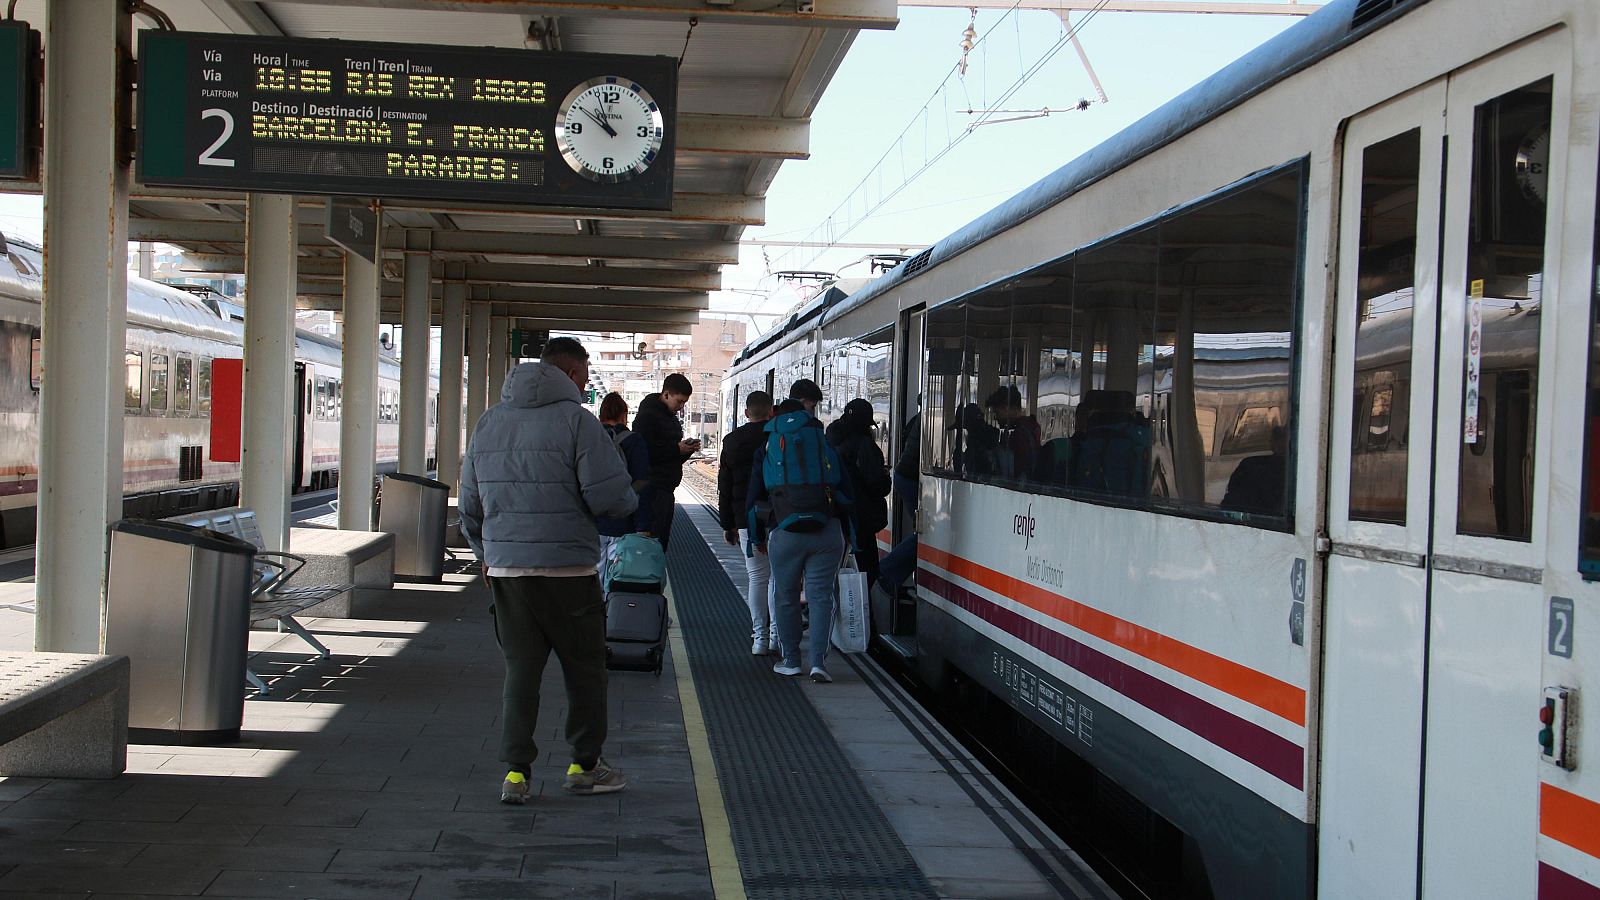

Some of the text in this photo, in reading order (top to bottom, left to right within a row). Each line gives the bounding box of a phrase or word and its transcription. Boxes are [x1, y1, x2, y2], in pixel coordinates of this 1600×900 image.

[203, 49, 222, 63] Vía
[253, 53, 310, 67] Hora TIME
[345, 58, 433, 73] Tren Tren TRAIN
[202, 69, 222, 81] Via
[347, 72, 392, 96] R15
[409, 75, 454, 99] REX
[201, 88, 239, 98] PLATFORM
[602, 91, 620, 104] 12
[252, 101, 428, 120] Destino Destinació DESTINATION
[252, 114, 391, 144] BARCELONA
[407, 122, 433, 146] E.
[571, 122, 583, 135] 9
[636, 125, 648, 138] 3
[198, 108, 235, 167] 2
[602, 157, 614, 169] 6
[1013, 503, 1036, 551] renfe
[847, 590, 857, 639] primark.com
[1554, 611, 1567, 653] 2
